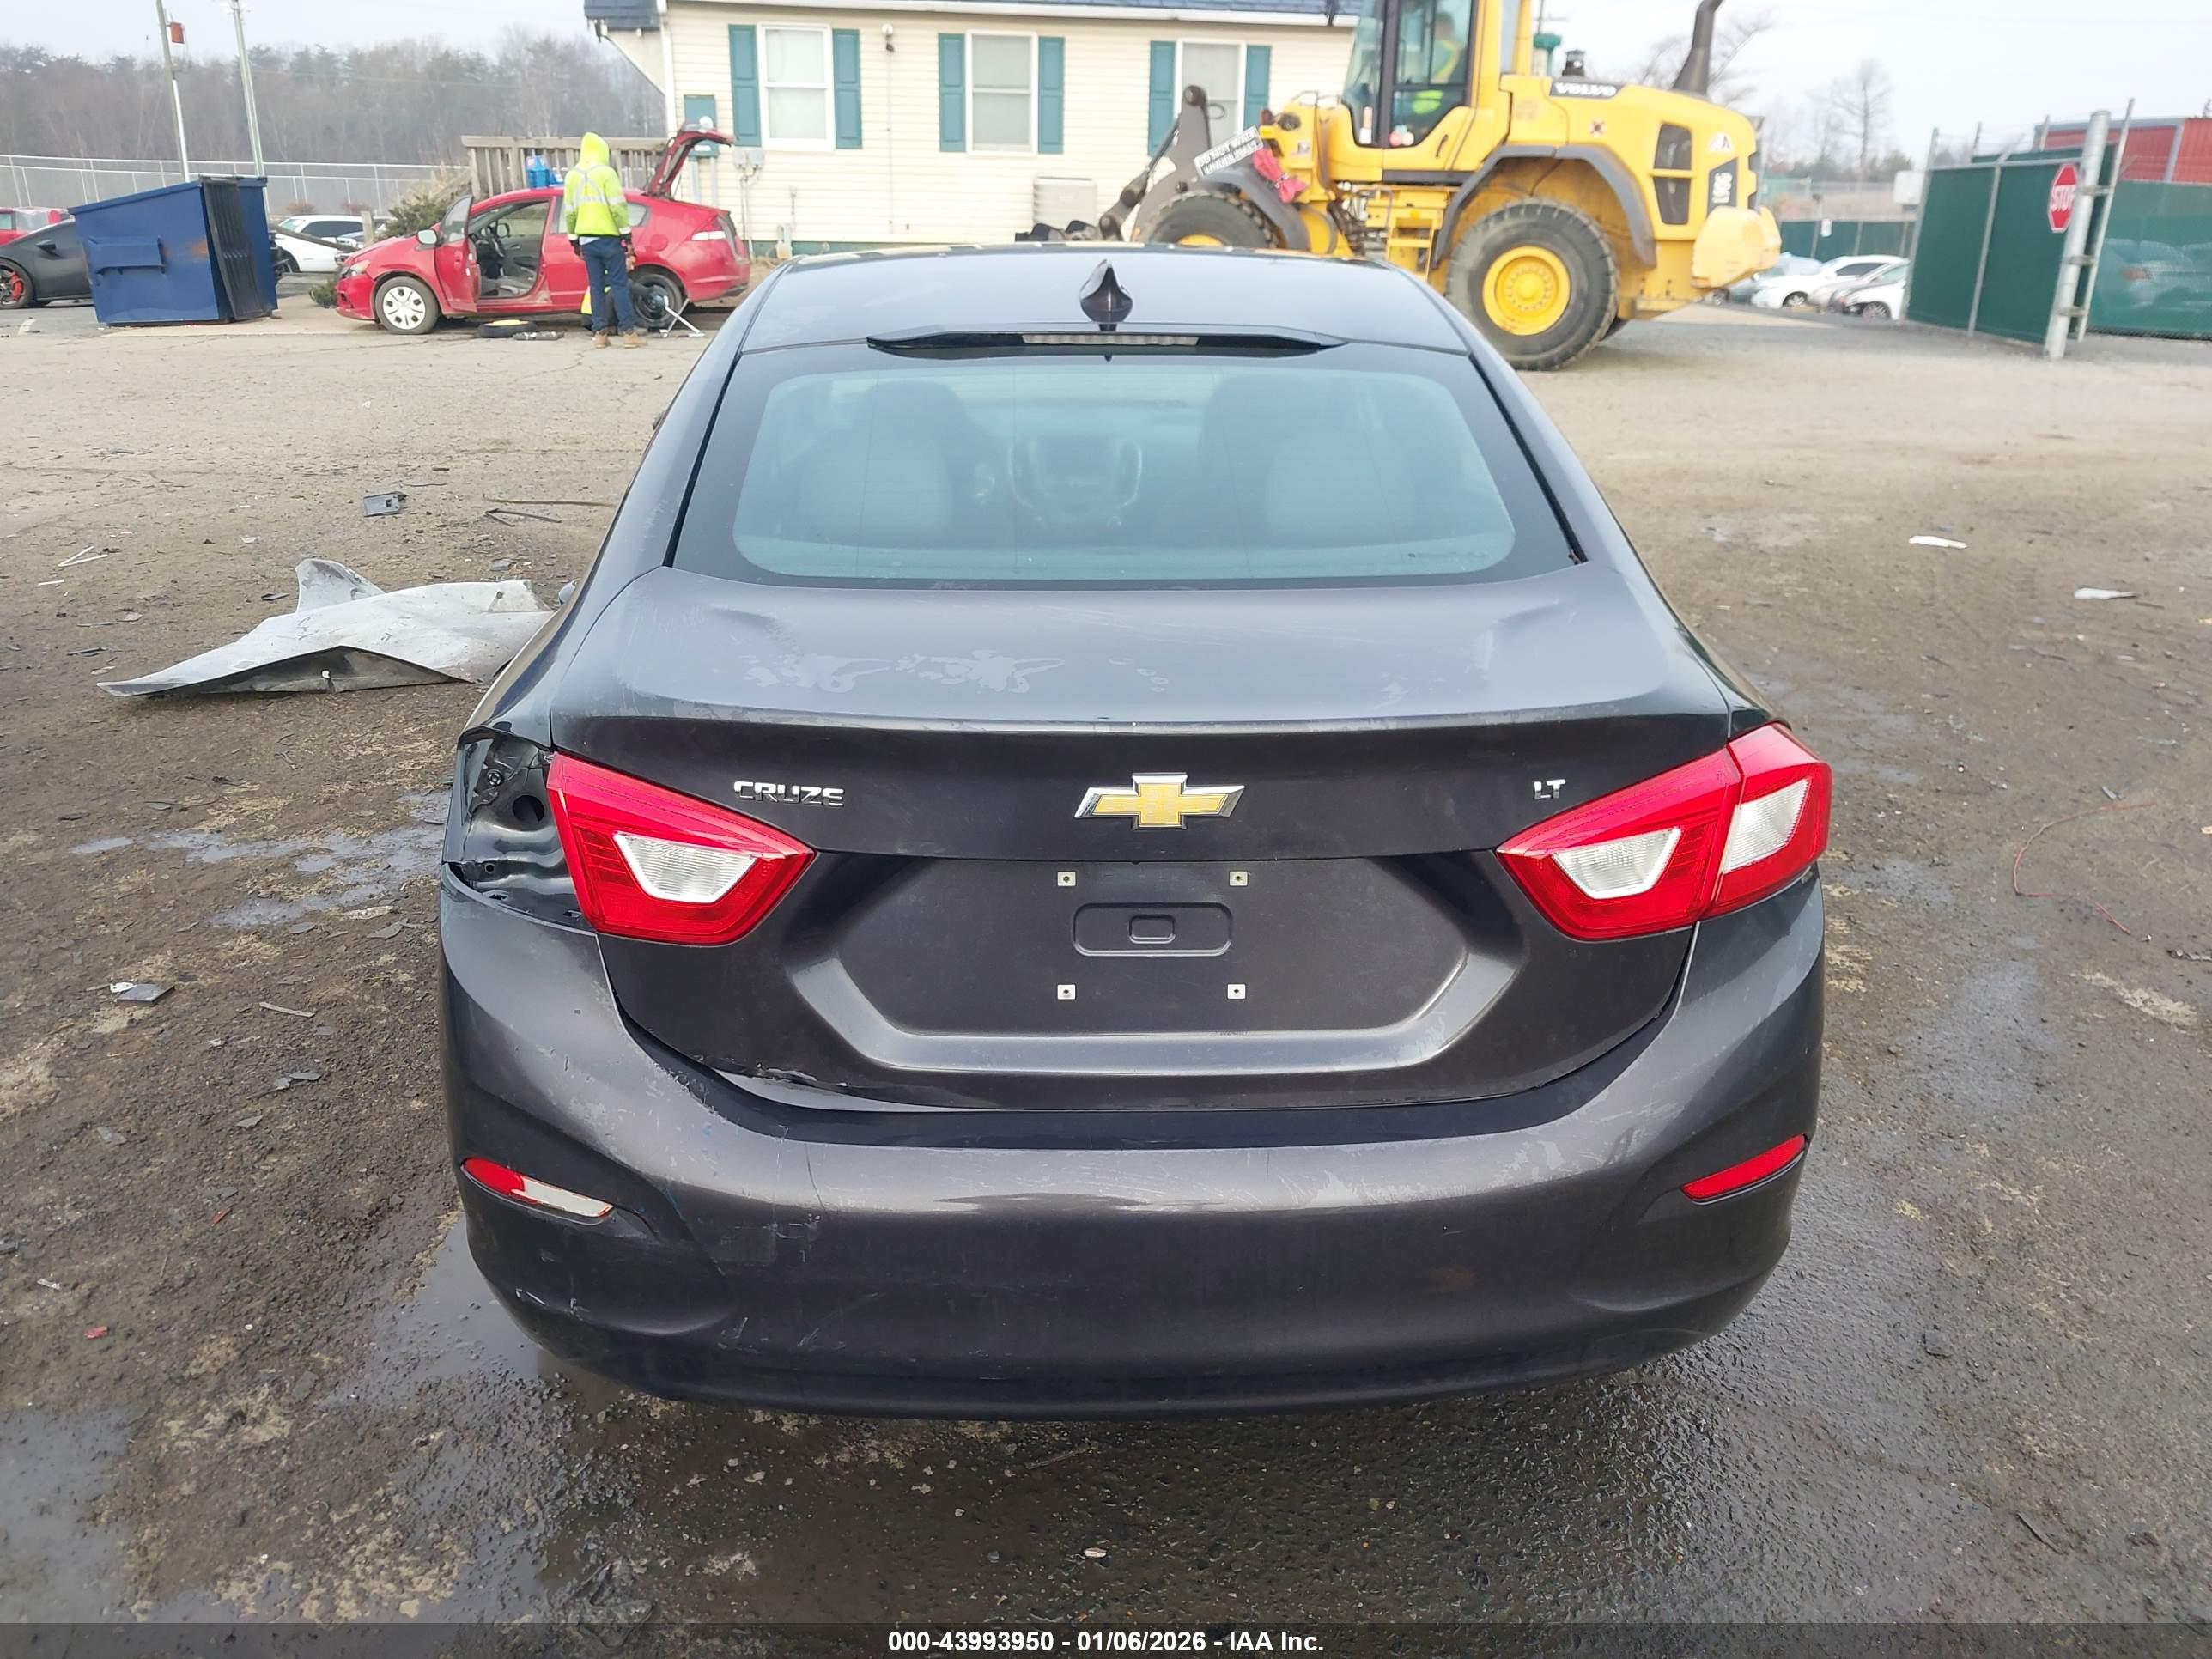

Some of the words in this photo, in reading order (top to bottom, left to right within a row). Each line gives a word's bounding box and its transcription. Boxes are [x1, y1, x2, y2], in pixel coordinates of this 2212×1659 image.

[1554, 82, 1617, 96] VOLVO
[734, 781, 844, 806] CRUZE
[1534, 779, 1566, 799] LT
